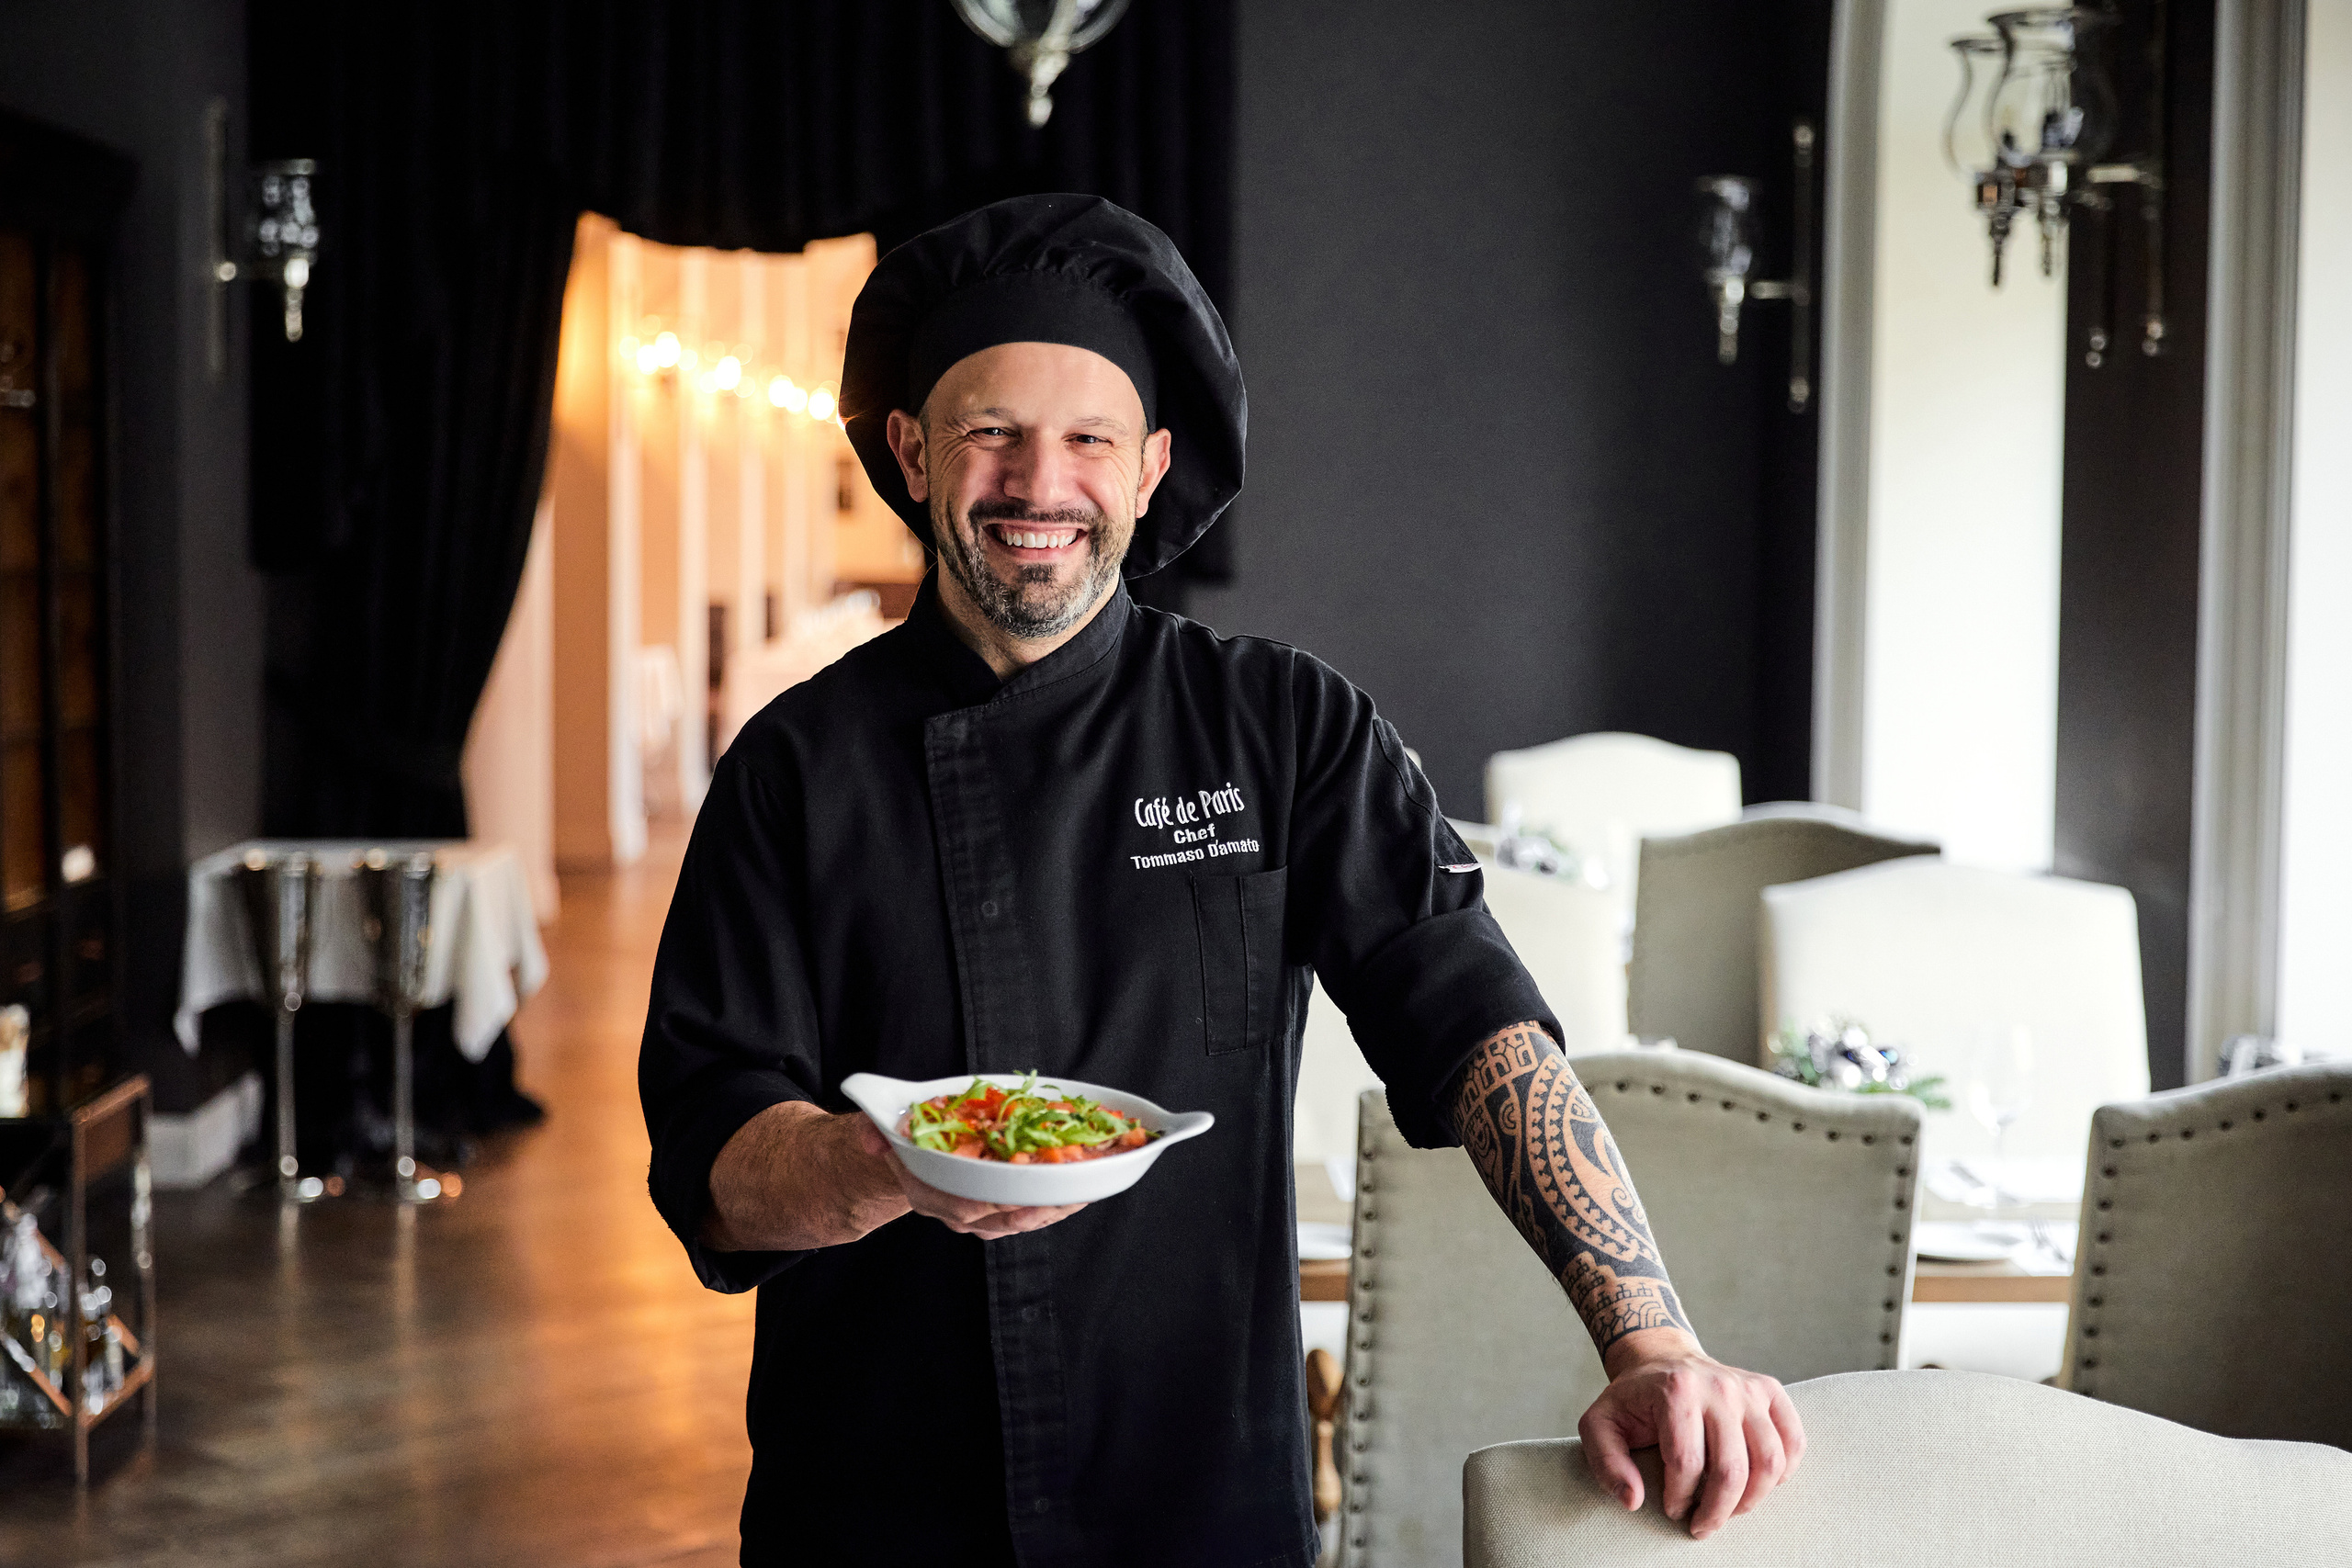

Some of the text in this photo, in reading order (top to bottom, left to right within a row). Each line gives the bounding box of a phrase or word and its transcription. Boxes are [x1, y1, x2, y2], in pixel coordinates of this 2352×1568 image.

[1135, 782, 1245, 829] Café de Paris
[1173, 823, 1216, 844] Chef
[1130, 838, 1260, 870] Tommaso D'amato
